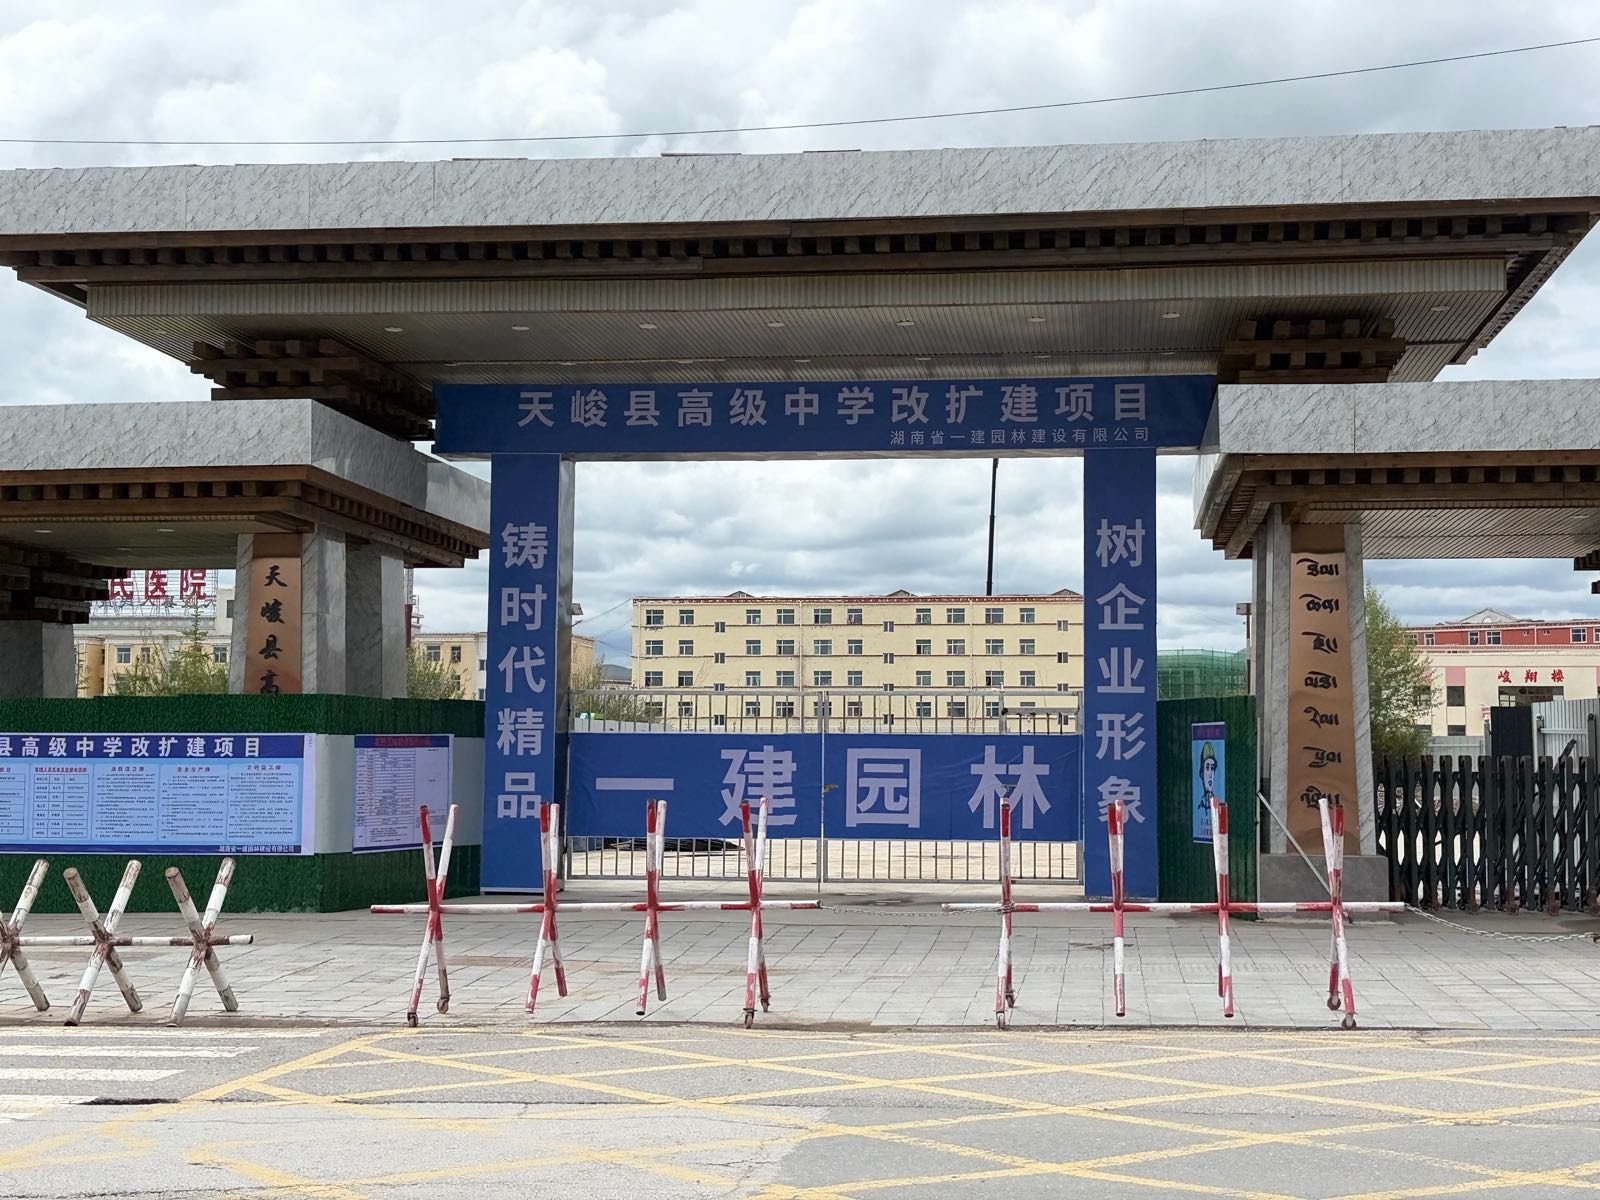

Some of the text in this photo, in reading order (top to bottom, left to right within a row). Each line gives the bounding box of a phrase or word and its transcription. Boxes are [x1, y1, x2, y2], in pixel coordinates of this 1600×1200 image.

[517, 383, 1147, 427] 天峻县高级中学改扩建项目
[889, 427, 1150, 445] 湖南省一建园林建设有限公司
[497, 522, 549, 819] 铸时代精品
[1095, 518, 1146, 824] 树企业形象
[0, 736, 261, 758] 县高级中学改扩建项目
[595, 744, 1052, 830] 一建园林
